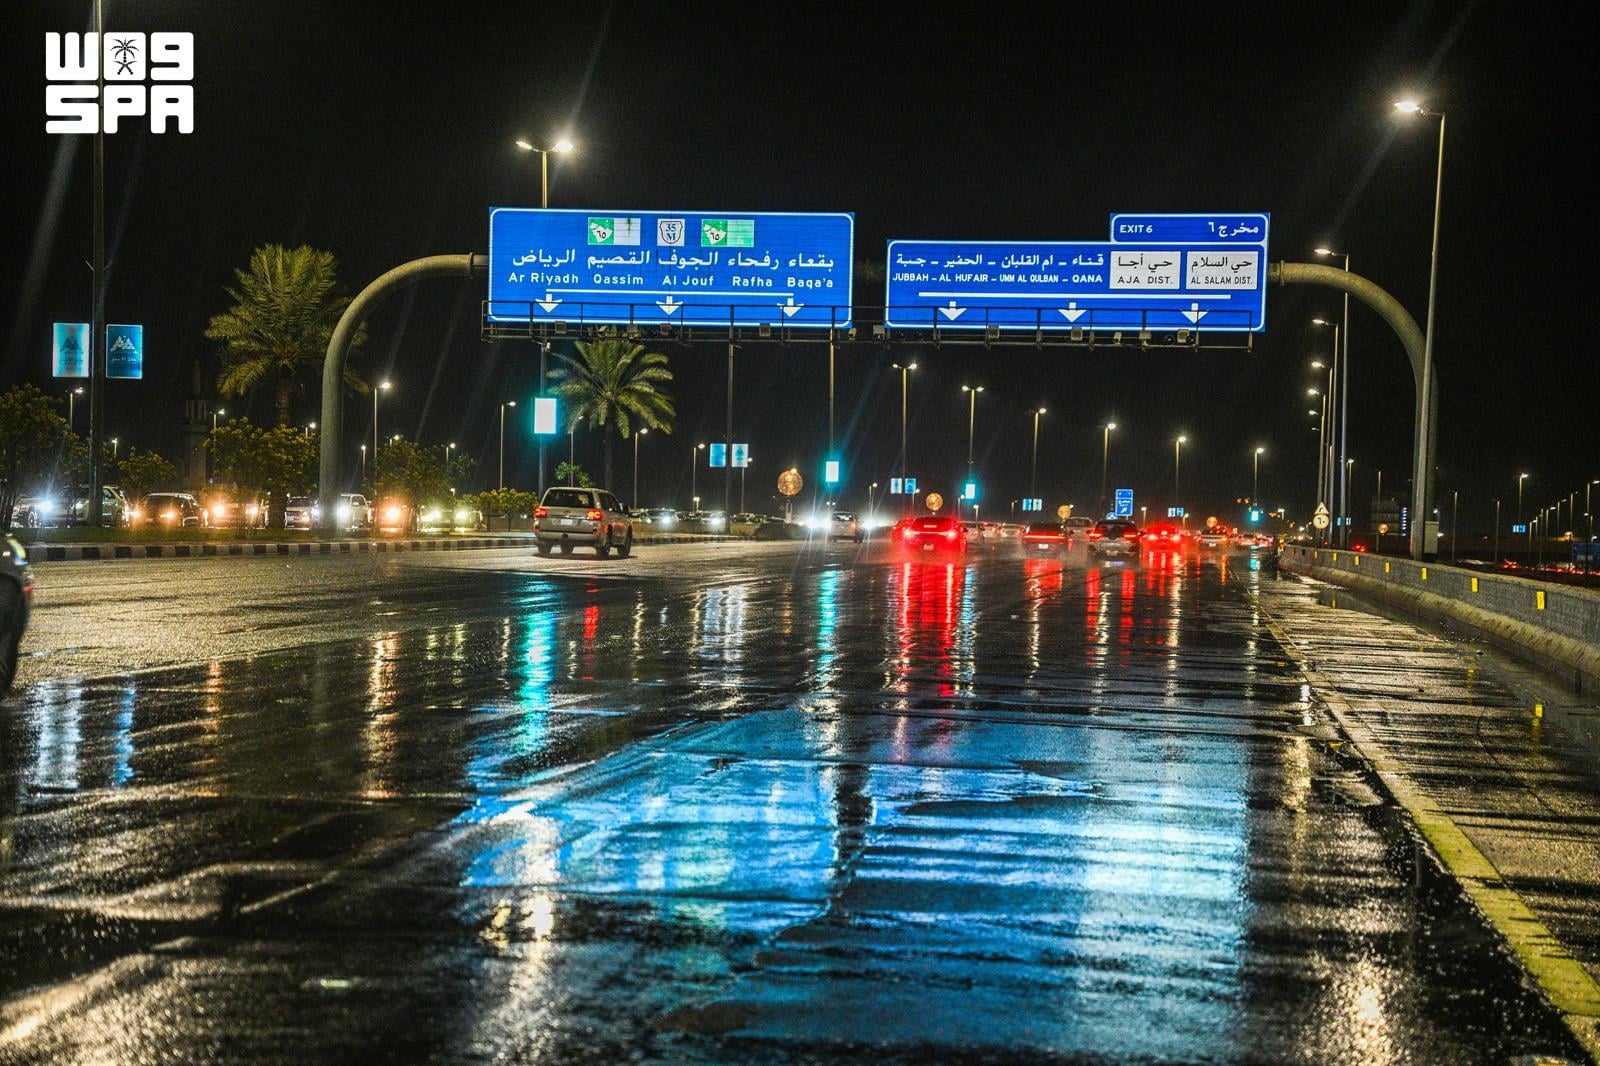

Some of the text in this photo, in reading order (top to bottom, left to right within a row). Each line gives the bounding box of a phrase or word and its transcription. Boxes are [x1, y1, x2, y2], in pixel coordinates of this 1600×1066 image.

[665, 223, 677, 232] 35
[1120, 225, 1153, 234] EXIT 6
[1208, 221, 1258, 237] مخرج ٦
[666, 232, 677, 241] M
[512, 249, 834, 272] بقعاء رفحاء الجوف القصيم الرياض
[944, 255, 982, 267] الحفير
[1002, 255, 1039, 268] القلبان
[1118, 253, 1173, 272] حي أجا
[1192, 257, 1252, 273] حي السلام
[509, 273, 579, 286] Ar Riyadh
[594, 274, 644, 285] Qassim
[663, 276, 714, 286] Al Jouf
[733, 276, 773, 287] Rafha
[788, 277, 833, 289] Baqa'a
[893, 273, 929, 282] JUBBAH
[939, 274, 952, 282] AL
[956, 274, 989, 283] HUFAIR
[1000, 274, 1015, 283] UMM
[1018, 275, 1028, 283] AL
[1030, 274, 1059, 283] QULBAN
[1072, 275, 1103, 283] QANA
[1118, 276, 1174, 284] AJA DIST.
[1191, 276, 1253, 285] AL SALAM DIST.
